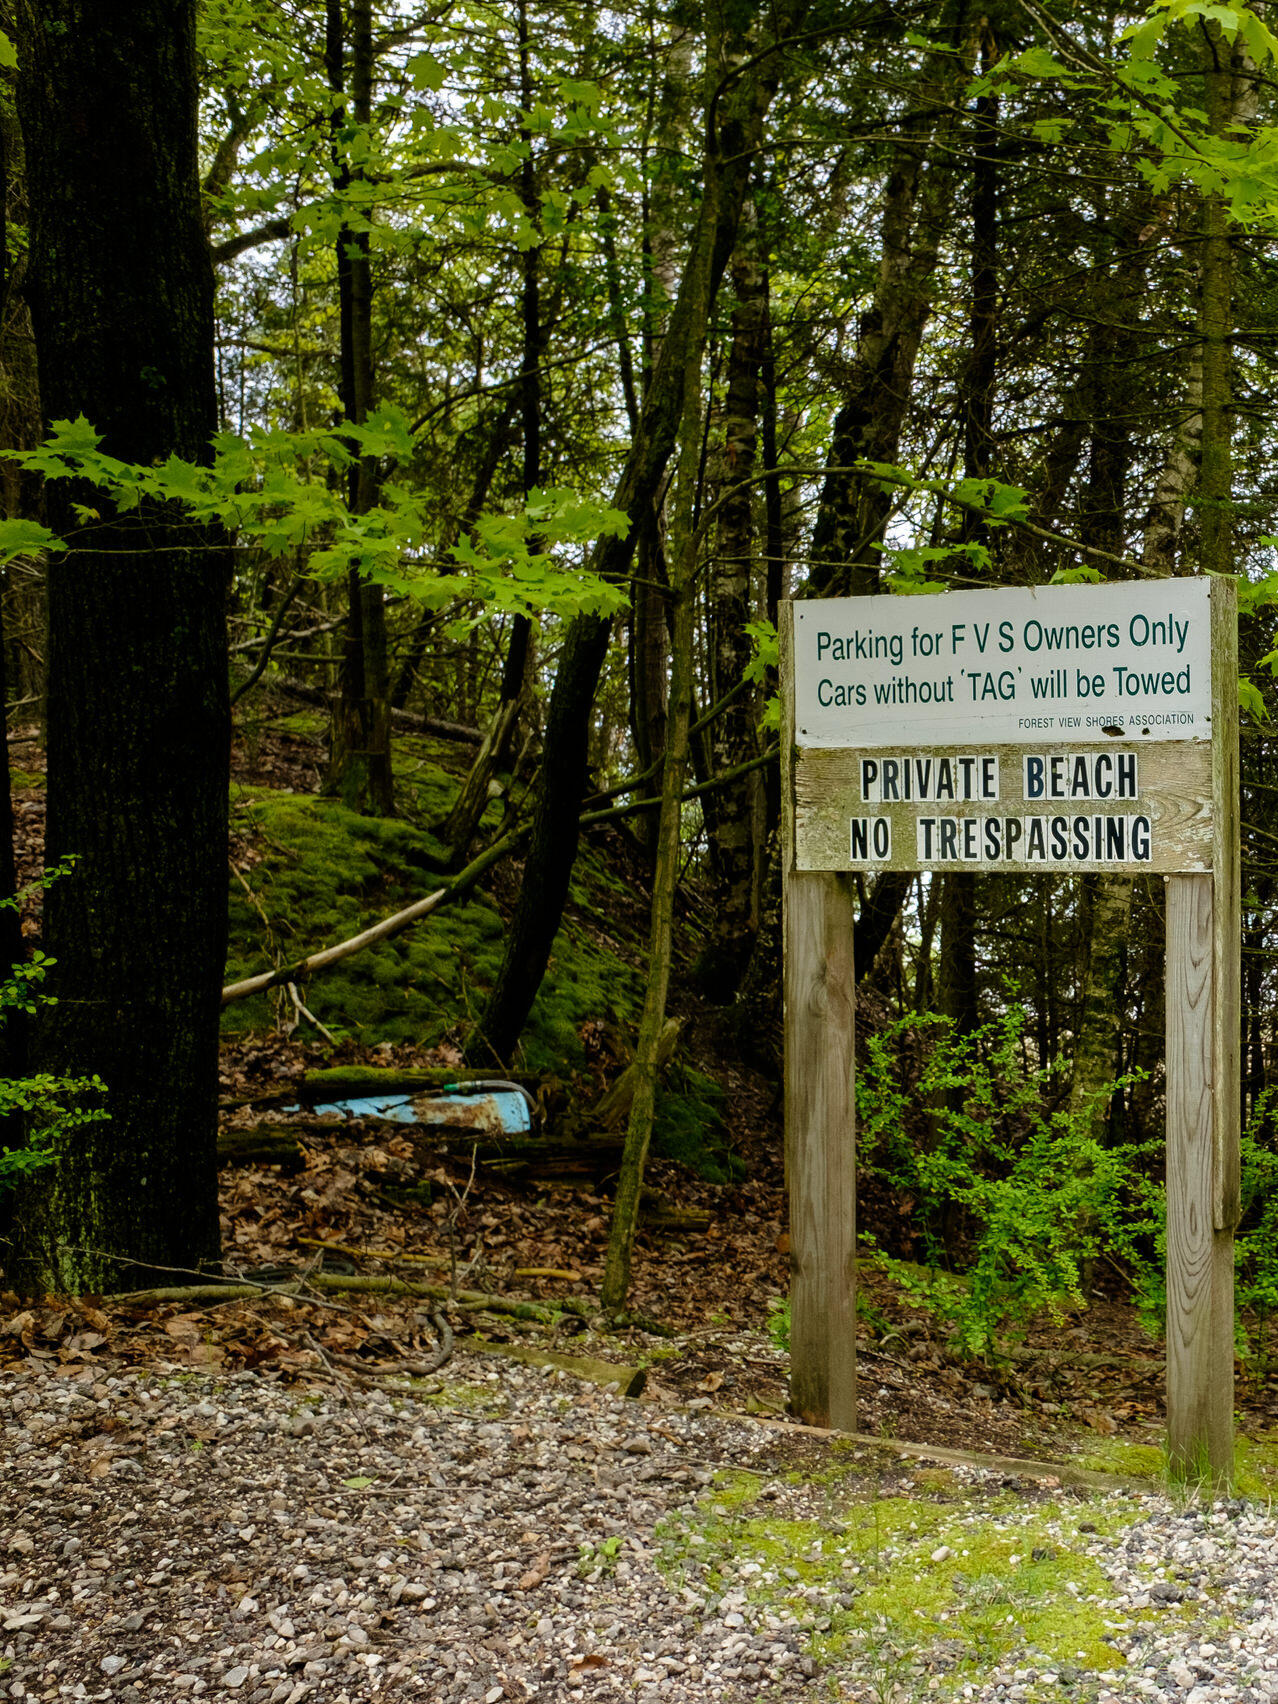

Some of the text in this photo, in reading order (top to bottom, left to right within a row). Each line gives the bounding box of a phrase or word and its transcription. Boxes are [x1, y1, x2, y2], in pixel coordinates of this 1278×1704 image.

[816, 629, 903, 666] Parking
[912, 627, 943, 657] for
[1023, 619, 1120, 651] Owners
[1129, 613, 1189, 653] Only
[817, 678, 867, 707] Cars
[873, 675, 954, 704] without
[1030, 669, 1068, 699] will
[1077, 668, 1105, 697] be
[1113, 665, 1191, 696] Towed
[1018, 713, 1194, 728] FOREST VIEW SHORES ASSOCIATION
[862, 754, 1136, 800] PRIVATE BEACH
[851, 816, 1150, 860] NO TRESPASSING
